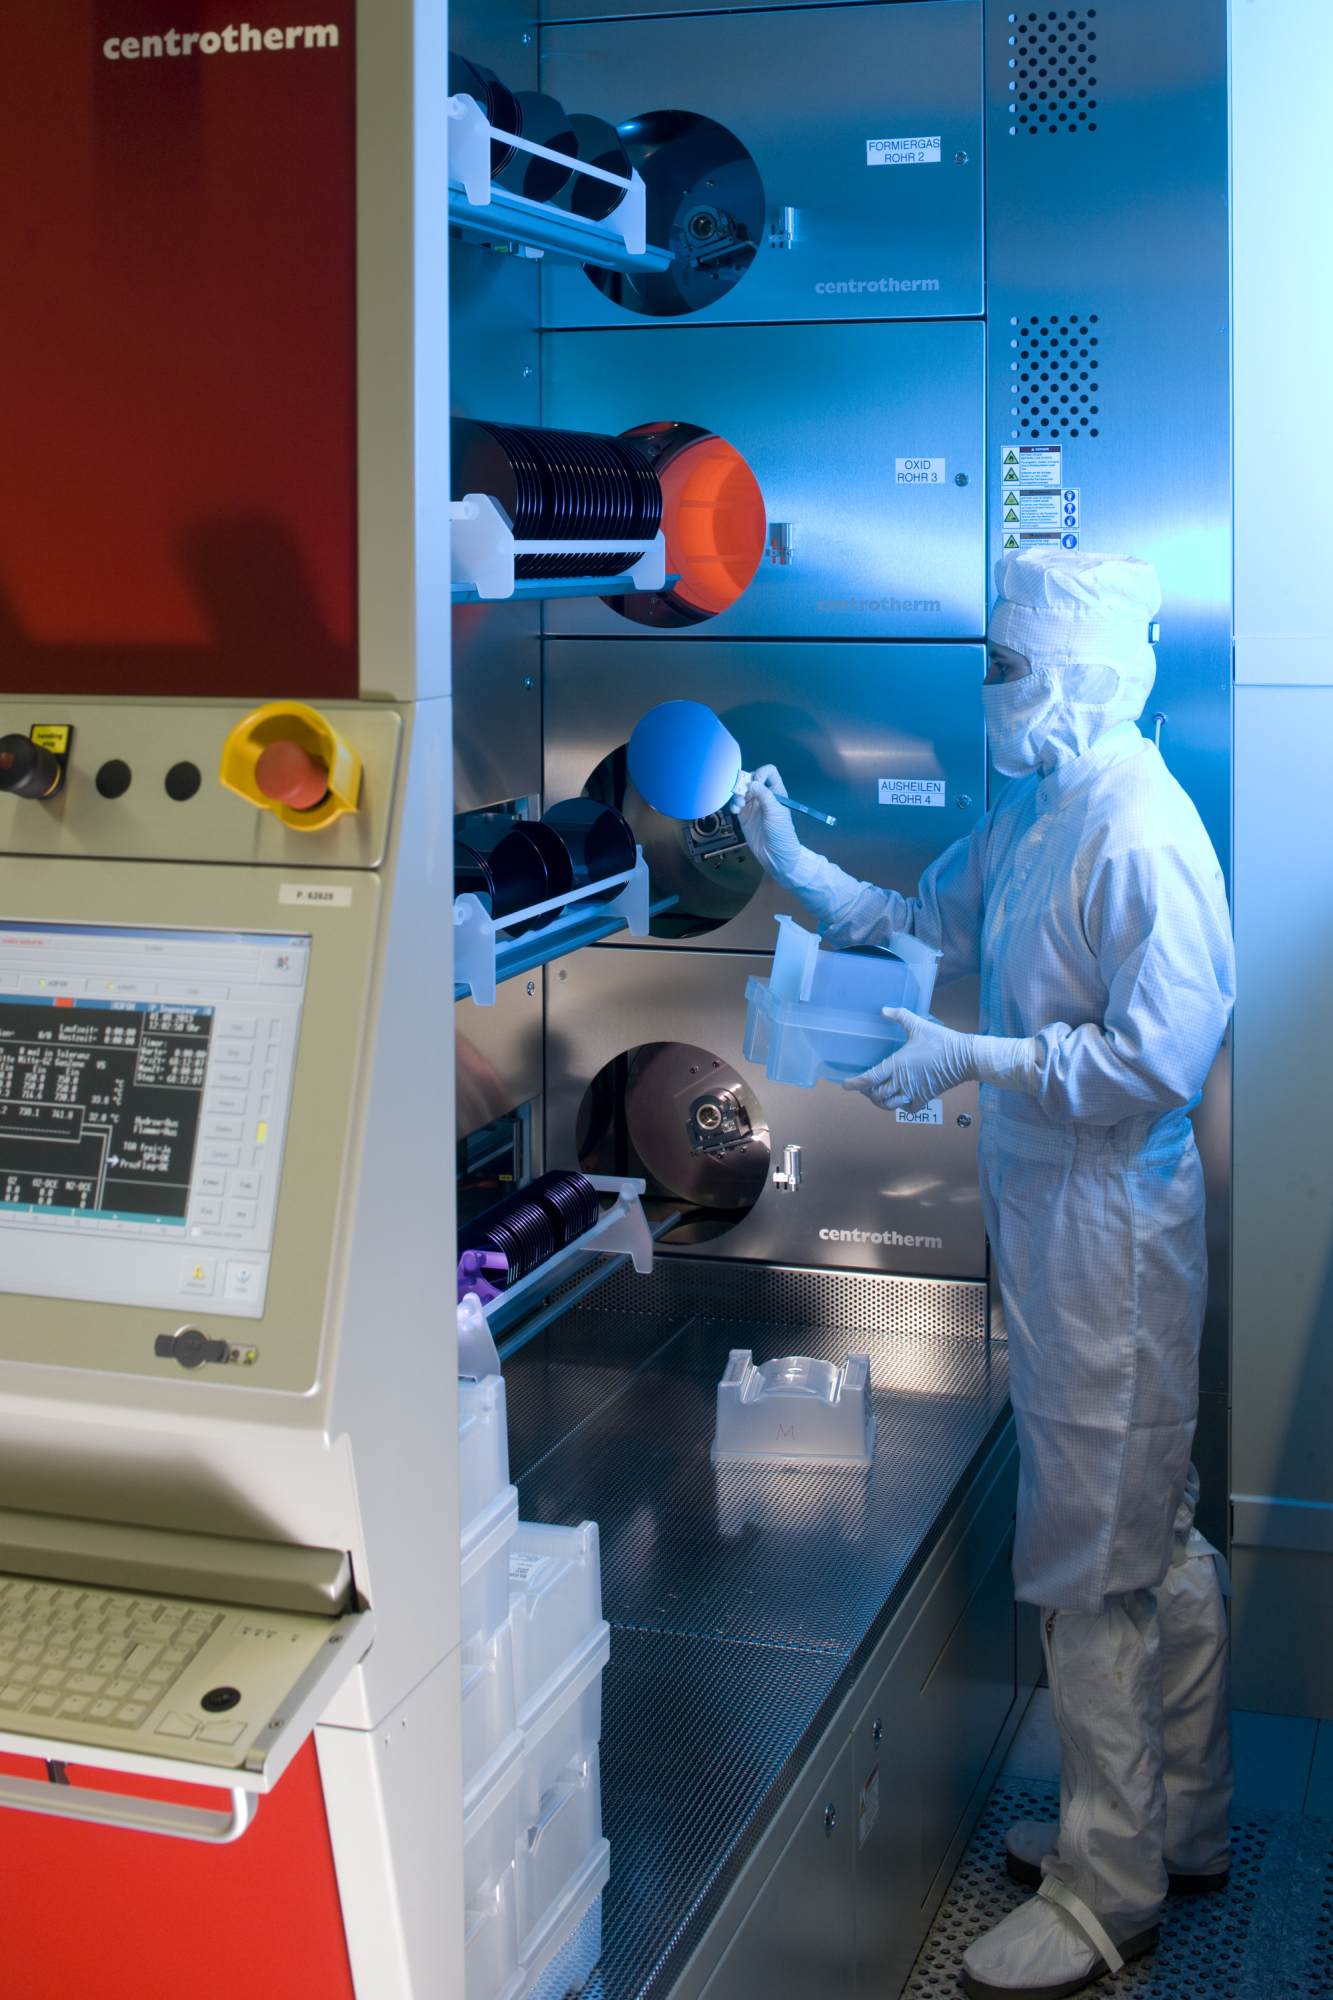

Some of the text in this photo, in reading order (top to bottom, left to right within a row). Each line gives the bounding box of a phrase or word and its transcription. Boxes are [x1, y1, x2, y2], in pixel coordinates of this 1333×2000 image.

[103, 23, 339, 60] centrotherm
[869, 138, 941, 151] FORMIERGAS
[884, 152, 925, 163] ROHR 2
[815, 278, 940, 294] centrotherm
[904, 460, 931, 470] OXID
[897, 473, 938, 482] ROHR 3
[817, 597, 941, 612] centrotherm
[881, 781, 941, 792] AUSHEILEN
[891, 794, 931, 804] ROHR 4
[899, 1111, 937, 1123] ROHR 1
[819, 1228, 942, 1249] centrotherm
[776, 1423, 795, 1440] M
